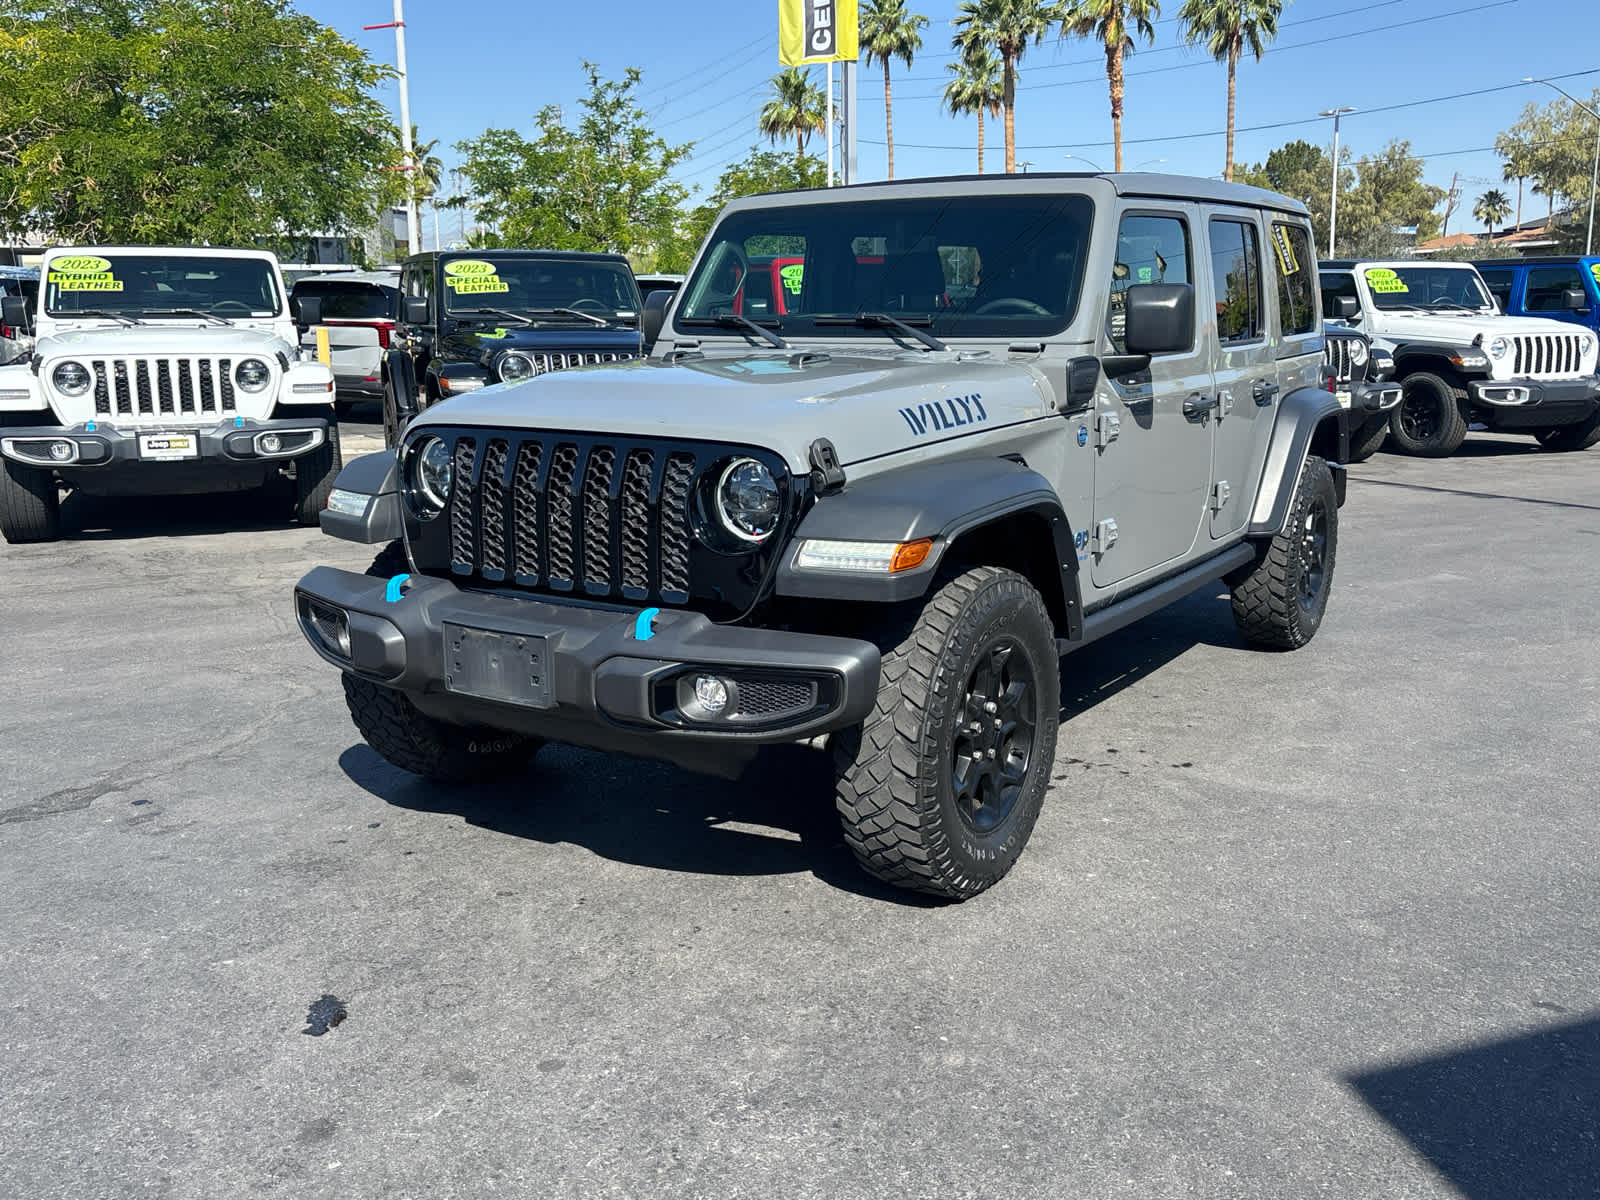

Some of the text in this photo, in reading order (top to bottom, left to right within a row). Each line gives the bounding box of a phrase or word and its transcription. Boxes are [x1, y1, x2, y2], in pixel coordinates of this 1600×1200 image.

[61, 259, 101, 269] 2023
[455, 264, 487, 273] 2023
[449, 276, 496, 285] SPECIAL
[457, 284, 506, 292] LEATHER
[897, 393, 987, 436] WILLYS
